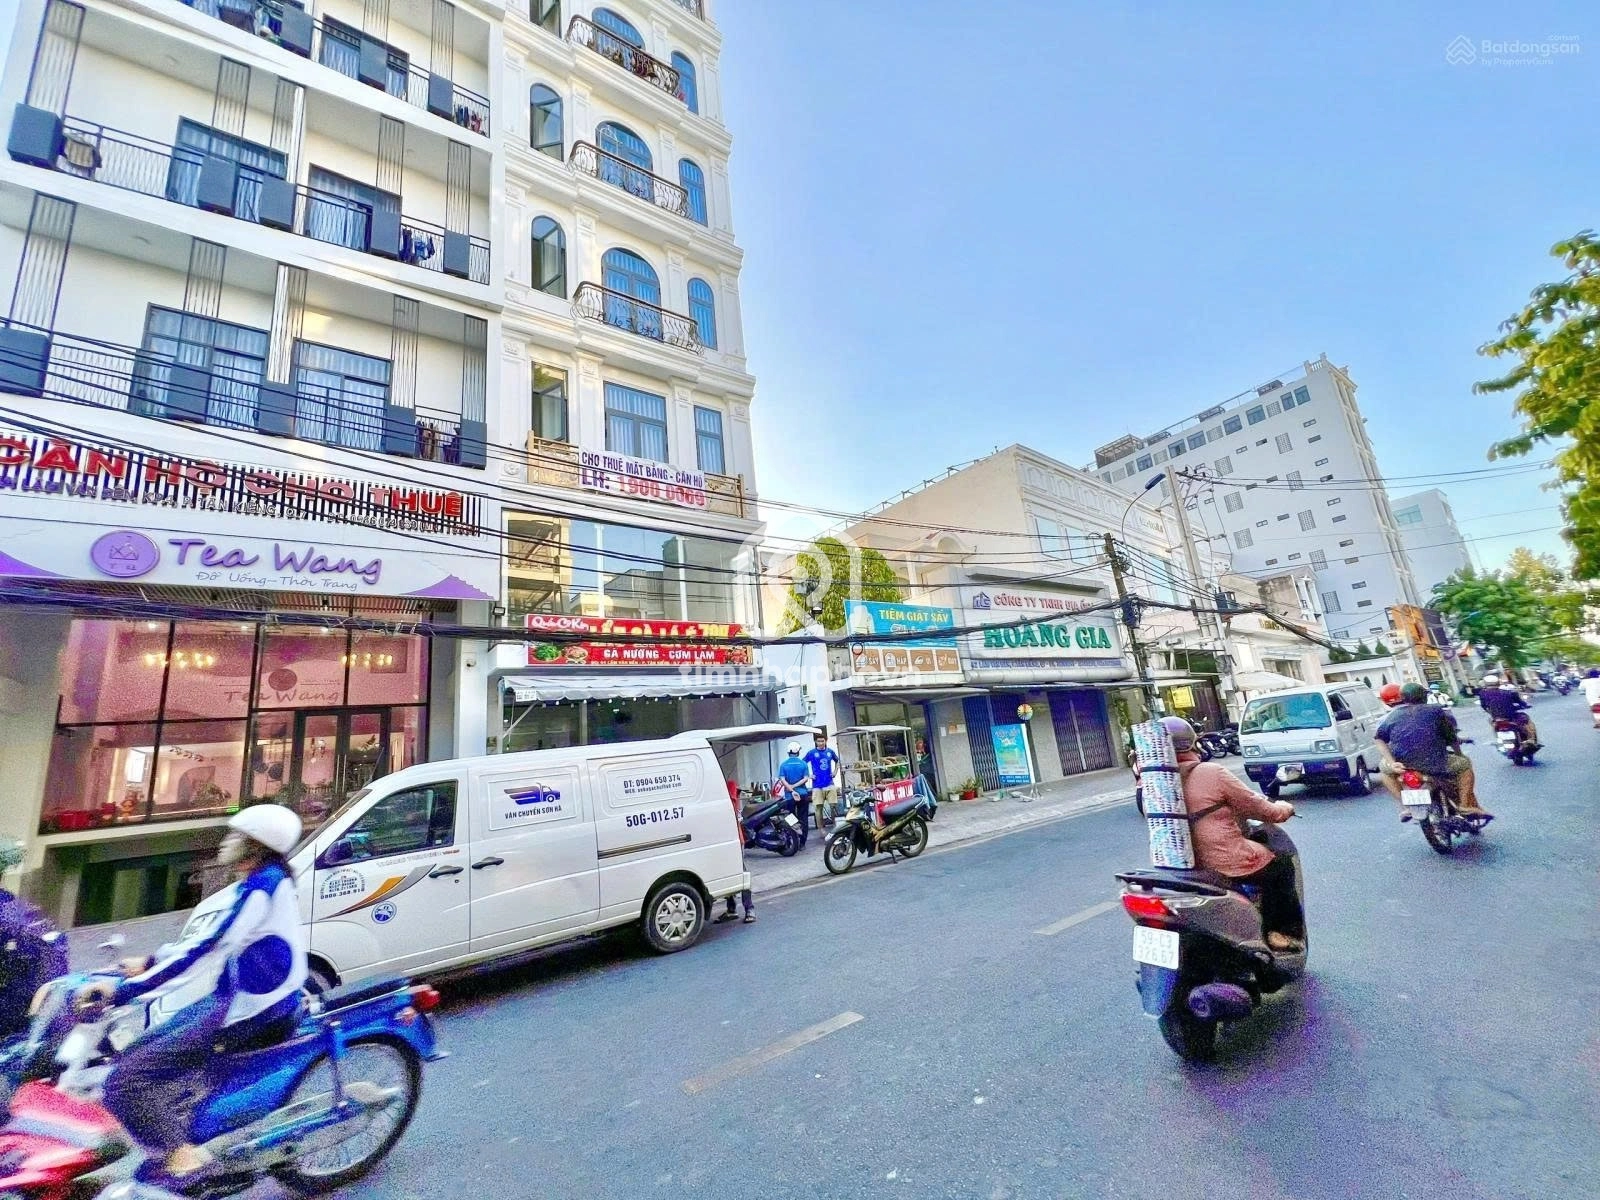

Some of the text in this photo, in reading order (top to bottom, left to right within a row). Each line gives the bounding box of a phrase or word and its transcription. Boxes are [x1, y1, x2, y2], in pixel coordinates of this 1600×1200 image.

[581, 451, 600, 466] CHO
[602, 455, 623, 472] THUÊ
[581, 467, 610, 490] LH:
[617, 474, 660, 498] 1900
[243, 471, 355, 504] CHO
[370, 488, 463, 517] THUÊ
[168, 537, 383, 585] Tea Wang
[321, 578, 358, 592] Trang
[993, 592, 1022, 607] CÔNG
[1023, 596, 1036, 609] TY
[1075, 626, 1112, 649] GIA
[623, 646, 660, 660] NƯỚNG
[668, 648, 691, 660] CƠM
[635, 778, 653, 787] 0904
[668, 774, 681, 783] 374
[625, 807, 685, 828] 50G-012.57
